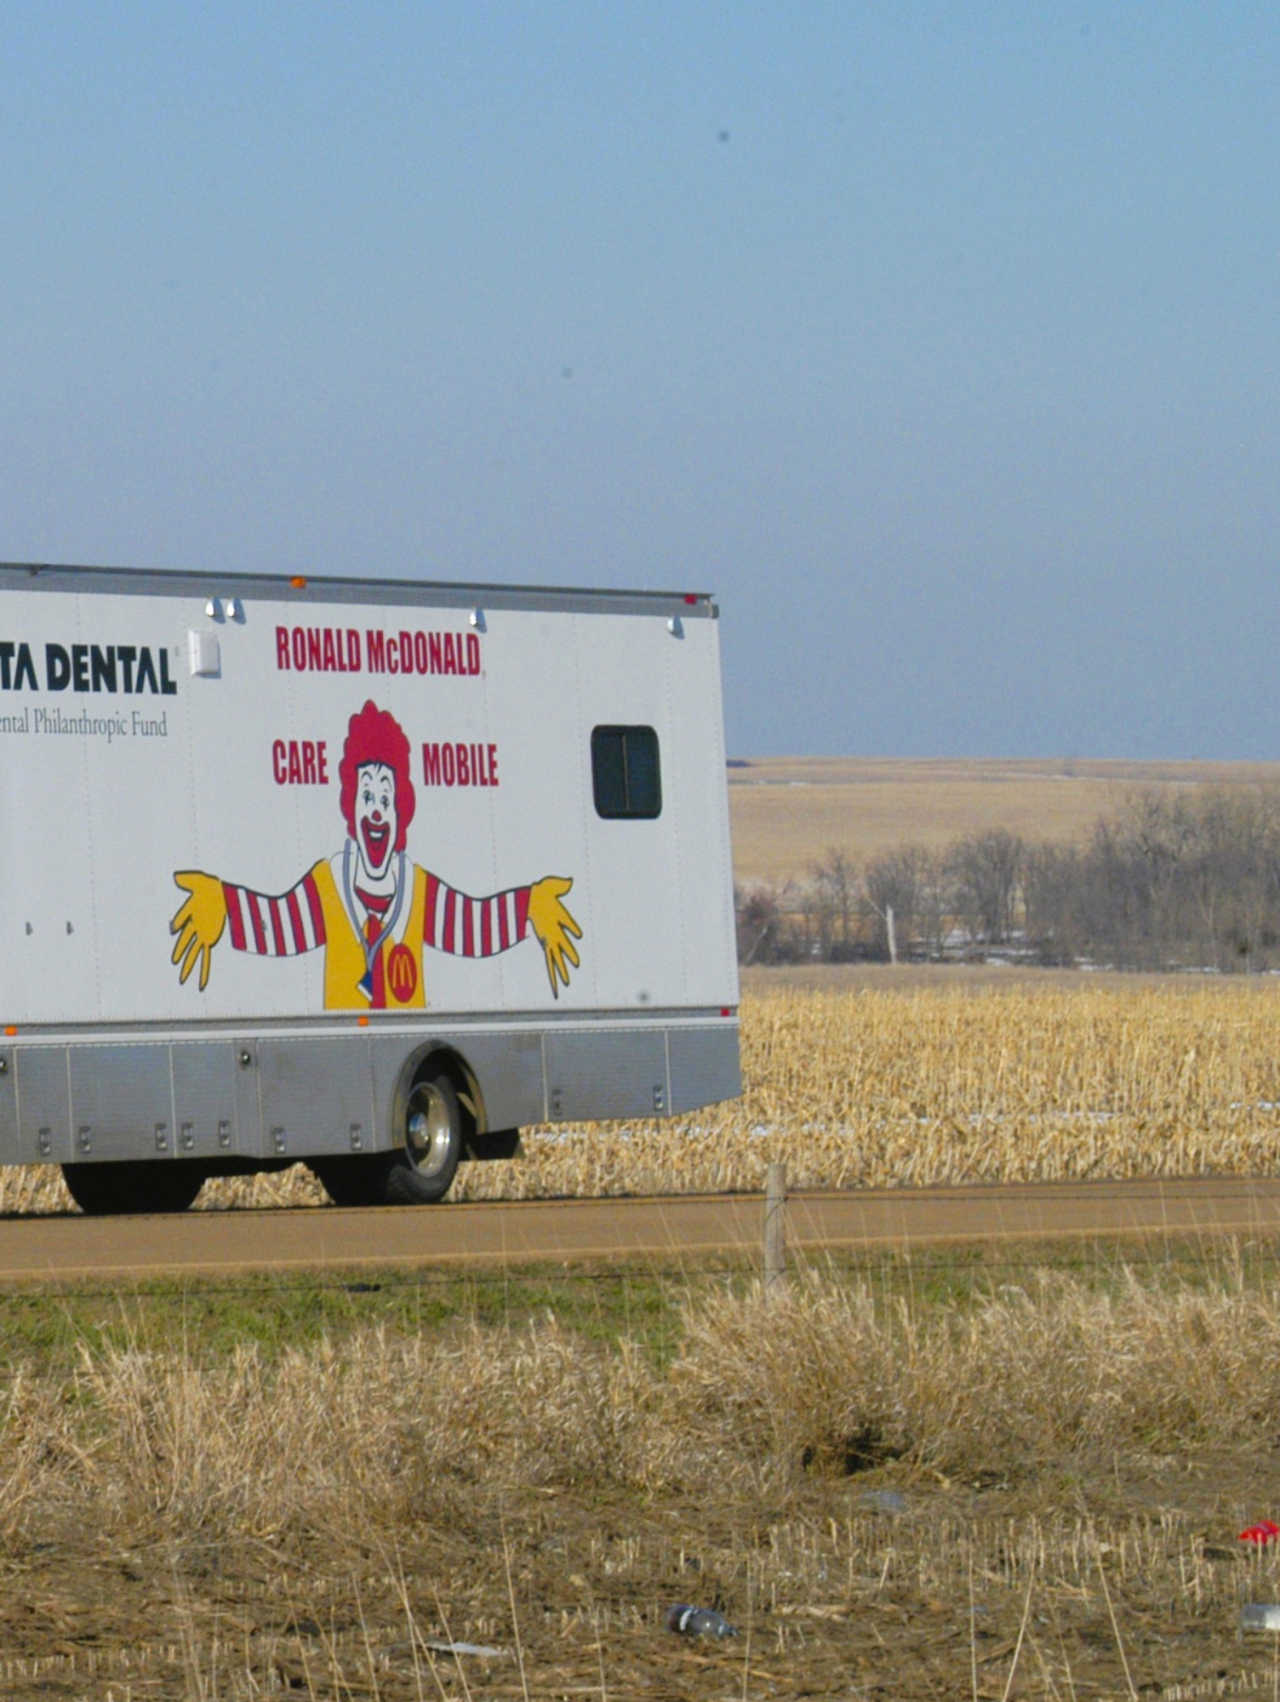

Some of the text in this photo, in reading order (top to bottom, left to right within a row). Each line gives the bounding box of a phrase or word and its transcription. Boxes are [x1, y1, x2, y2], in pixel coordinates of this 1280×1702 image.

[45, 643, 178, 695] DENTAL
[275, 626, 481, 676] RONALD McDONALD
[34, 708, 128, 743] Philanthropic
[132, 710, 168, 737] Fund
[272, 739, 329, 785] CARE
[422, 743, 500, 787] MOBILE
